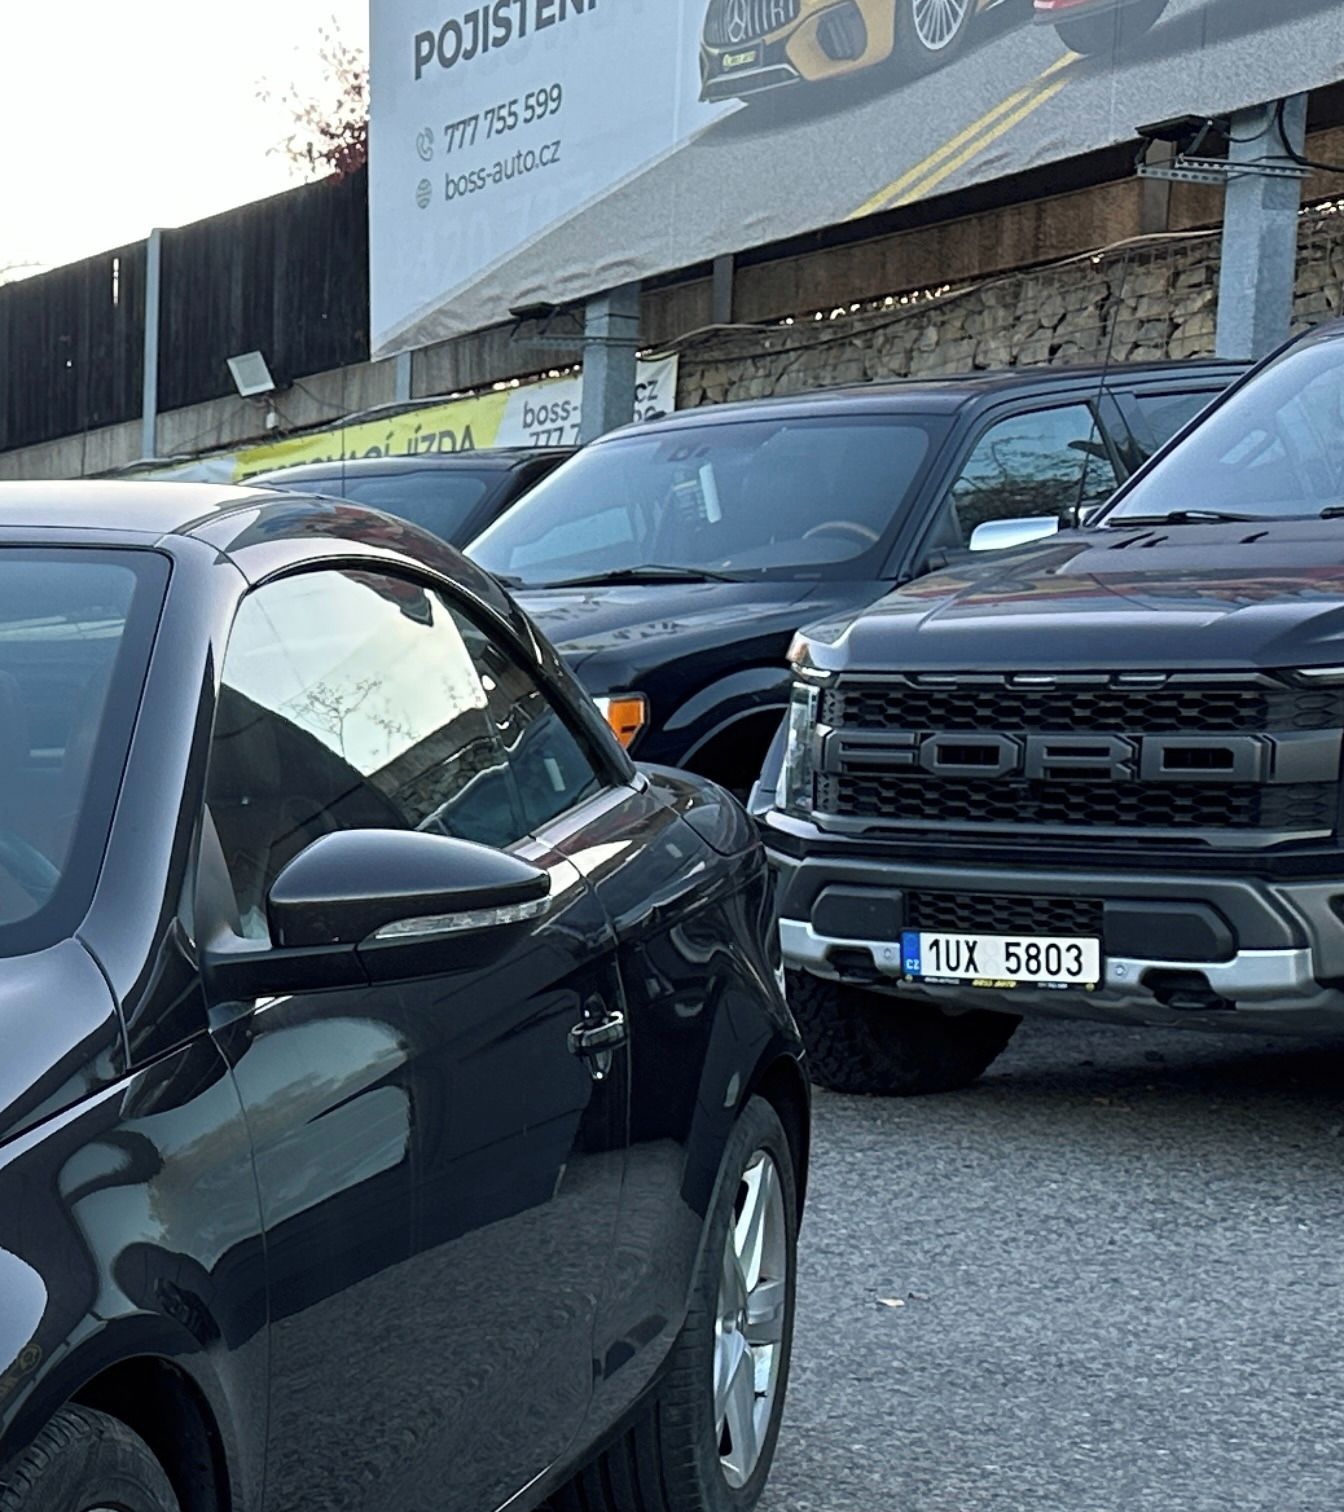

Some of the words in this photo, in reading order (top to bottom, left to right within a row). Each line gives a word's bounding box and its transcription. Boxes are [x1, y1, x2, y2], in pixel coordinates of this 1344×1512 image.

[443, 114, 479, 154] 777
[484, 99, 518, 139] 755
[523, 82, 563, 124] 599
[444, 139, 562, 201] boss-auto.cz
[825, 728, 1267, 783] FORD
[928, 937, 980, 974] 1UX
[1004, 941, 1083, 977] 5803
